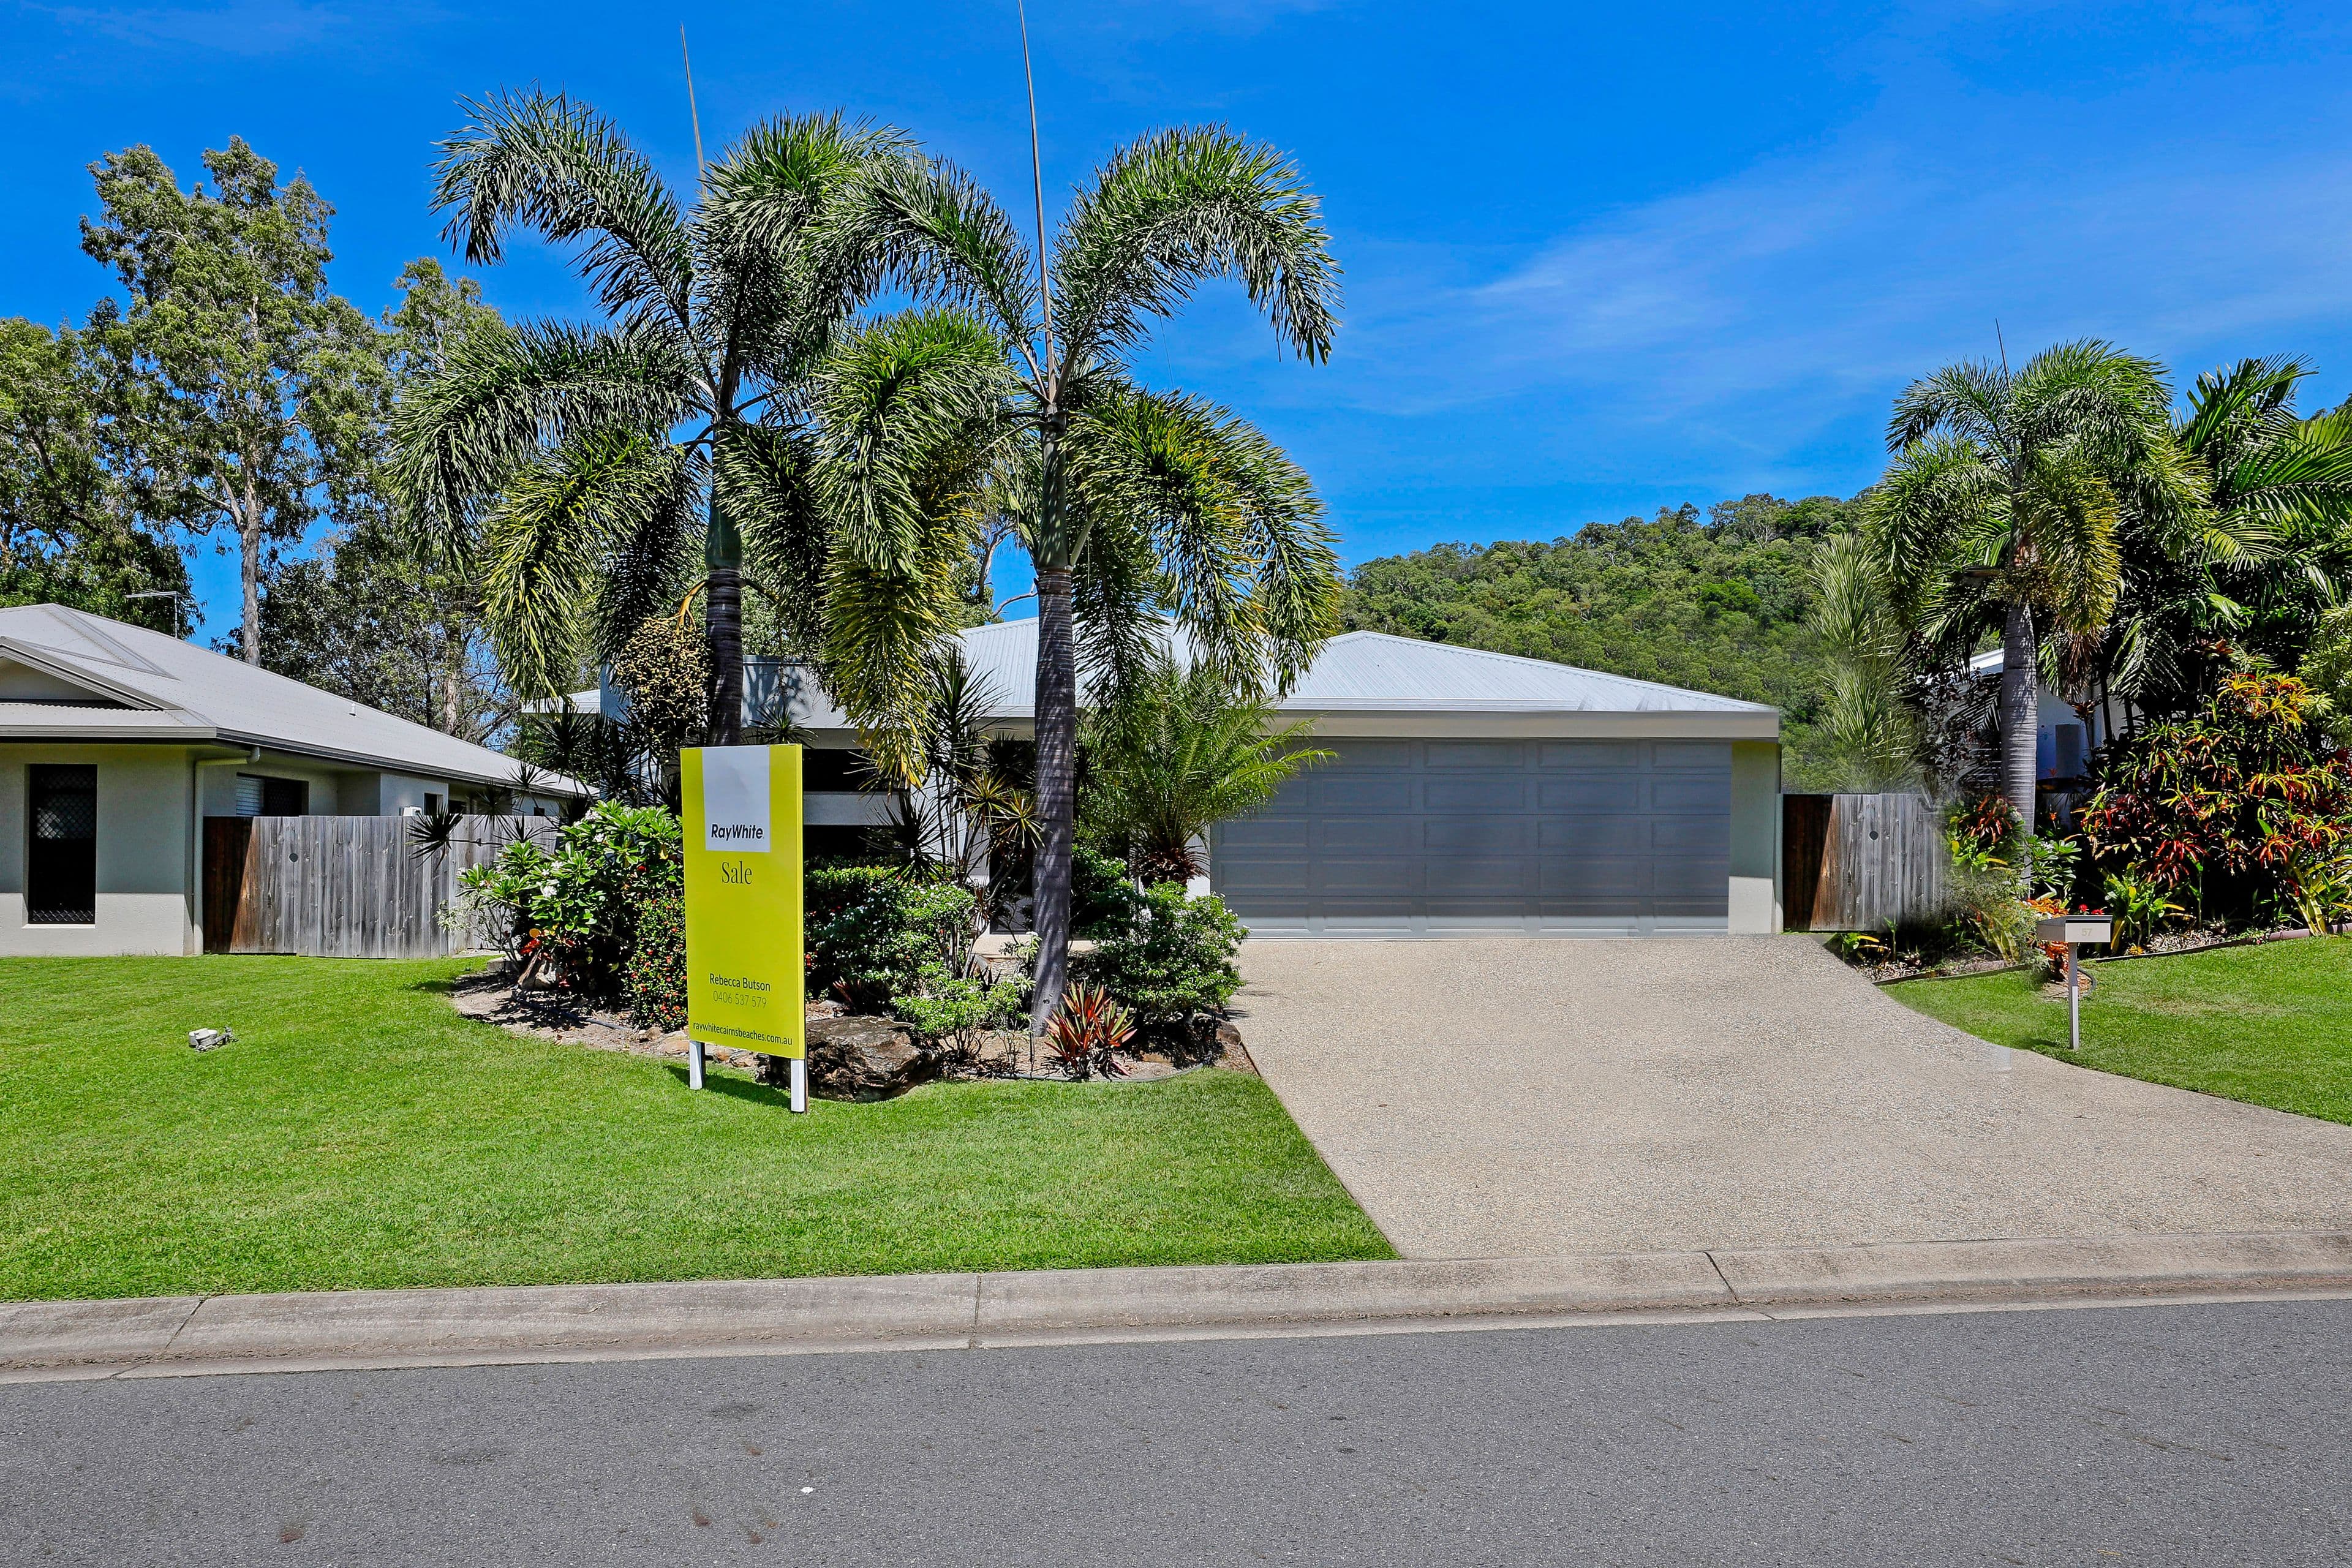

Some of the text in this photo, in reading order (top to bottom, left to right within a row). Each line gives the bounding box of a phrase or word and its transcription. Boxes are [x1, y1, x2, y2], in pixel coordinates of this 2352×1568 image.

[722, 861, 753, 884] Sale
[2082, 927, 2093, 937] 57
[710, 973, 771, 992] Rebecca Butson
[713, 990, 733, 1005] 0406
[752, 995, 767, 1009] 579
[693, 1022, 793, 1045] raywhitecairnsbeaches.com.au
